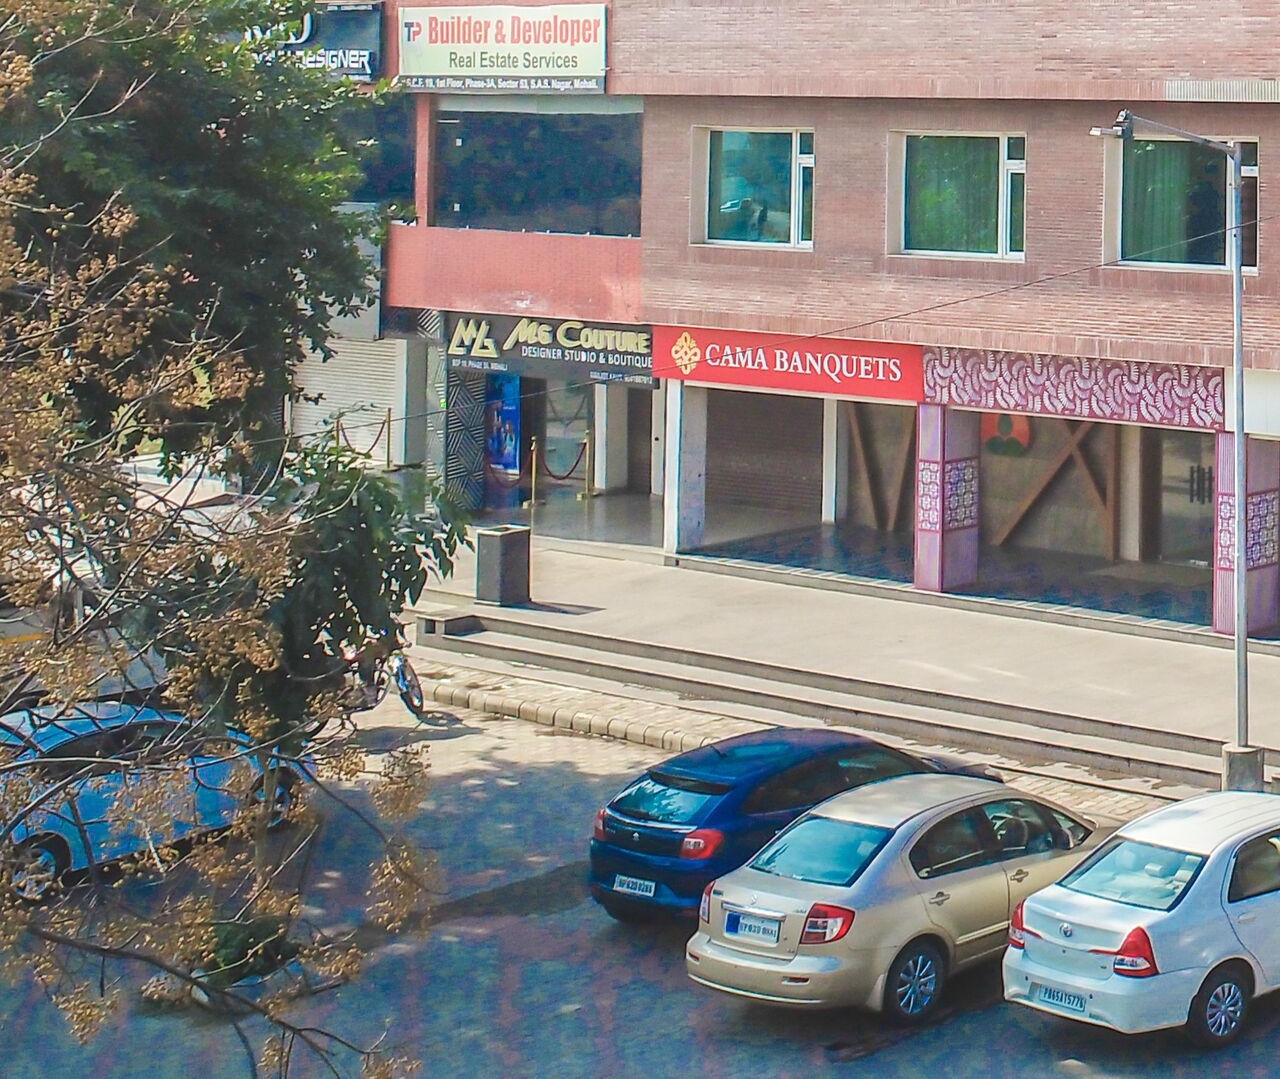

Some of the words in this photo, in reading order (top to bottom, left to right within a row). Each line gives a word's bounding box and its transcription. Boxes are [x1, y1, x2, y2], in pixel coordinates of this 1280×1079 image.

[428, 16, 491, 45] Builder
[494, 16, 506, 44] &
[510, 15, 601, 47] Developer
[449, 52, 476, 69] Real
[479, 51, 519, 69] Estate
[522, 51, 578, 69] Services
[521, 345, 563, 360] DESIGNER
[564, 346, 596, 363] STUDIO
[599, 352, 606, 364] &
[608, 353, 653, 369] BOUTIQUE
[705, 343, 768, 370] CAMA
[774, 349, 901, 383] BANQUETS
